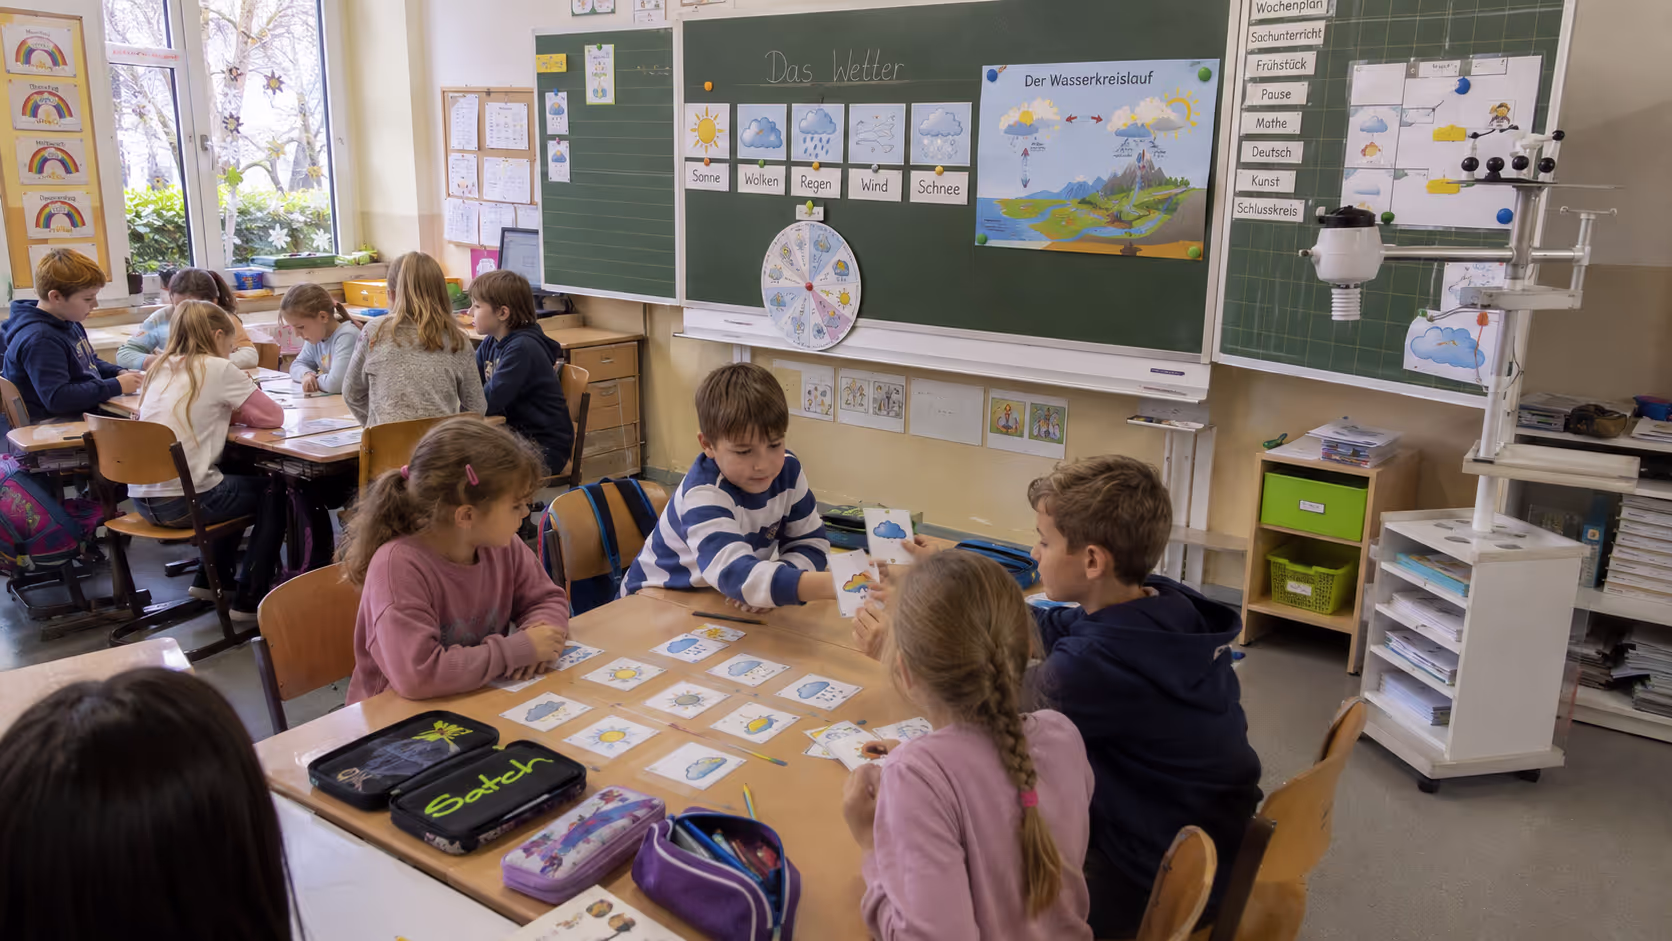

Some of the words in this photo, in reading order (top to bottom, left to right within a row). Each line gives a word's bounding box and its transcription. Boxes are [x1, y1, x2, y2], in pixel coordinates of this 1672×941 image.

[1256, 0, 1323, 14] Wochenplan
[1250, 28, 1322, 43] Sachunterricht
[765, 50, 813, 83] Das
[833, 49, 904, 81] Wetter
[1256, 57, 1307, 71] Frühstück
[1025, 74, 1047, 87] Der
[1050, 71, 1154, 87] Wasserkreislauf
[1261, 88, 1292, 100] Pause
[1252, 146, 1292, 158] Deutsch
[692, 170, 721, 184] Sonne
[745, 172, 779, 187] Wolken
[801, 174, 832, 193] Regen
[1251, 174, 1280, 187] Kunst
[861, 177, 888, 193] Wind
[917, 180, 961, 195] Schnee
[1237, 202, 1298, 217] Schlusskreis
